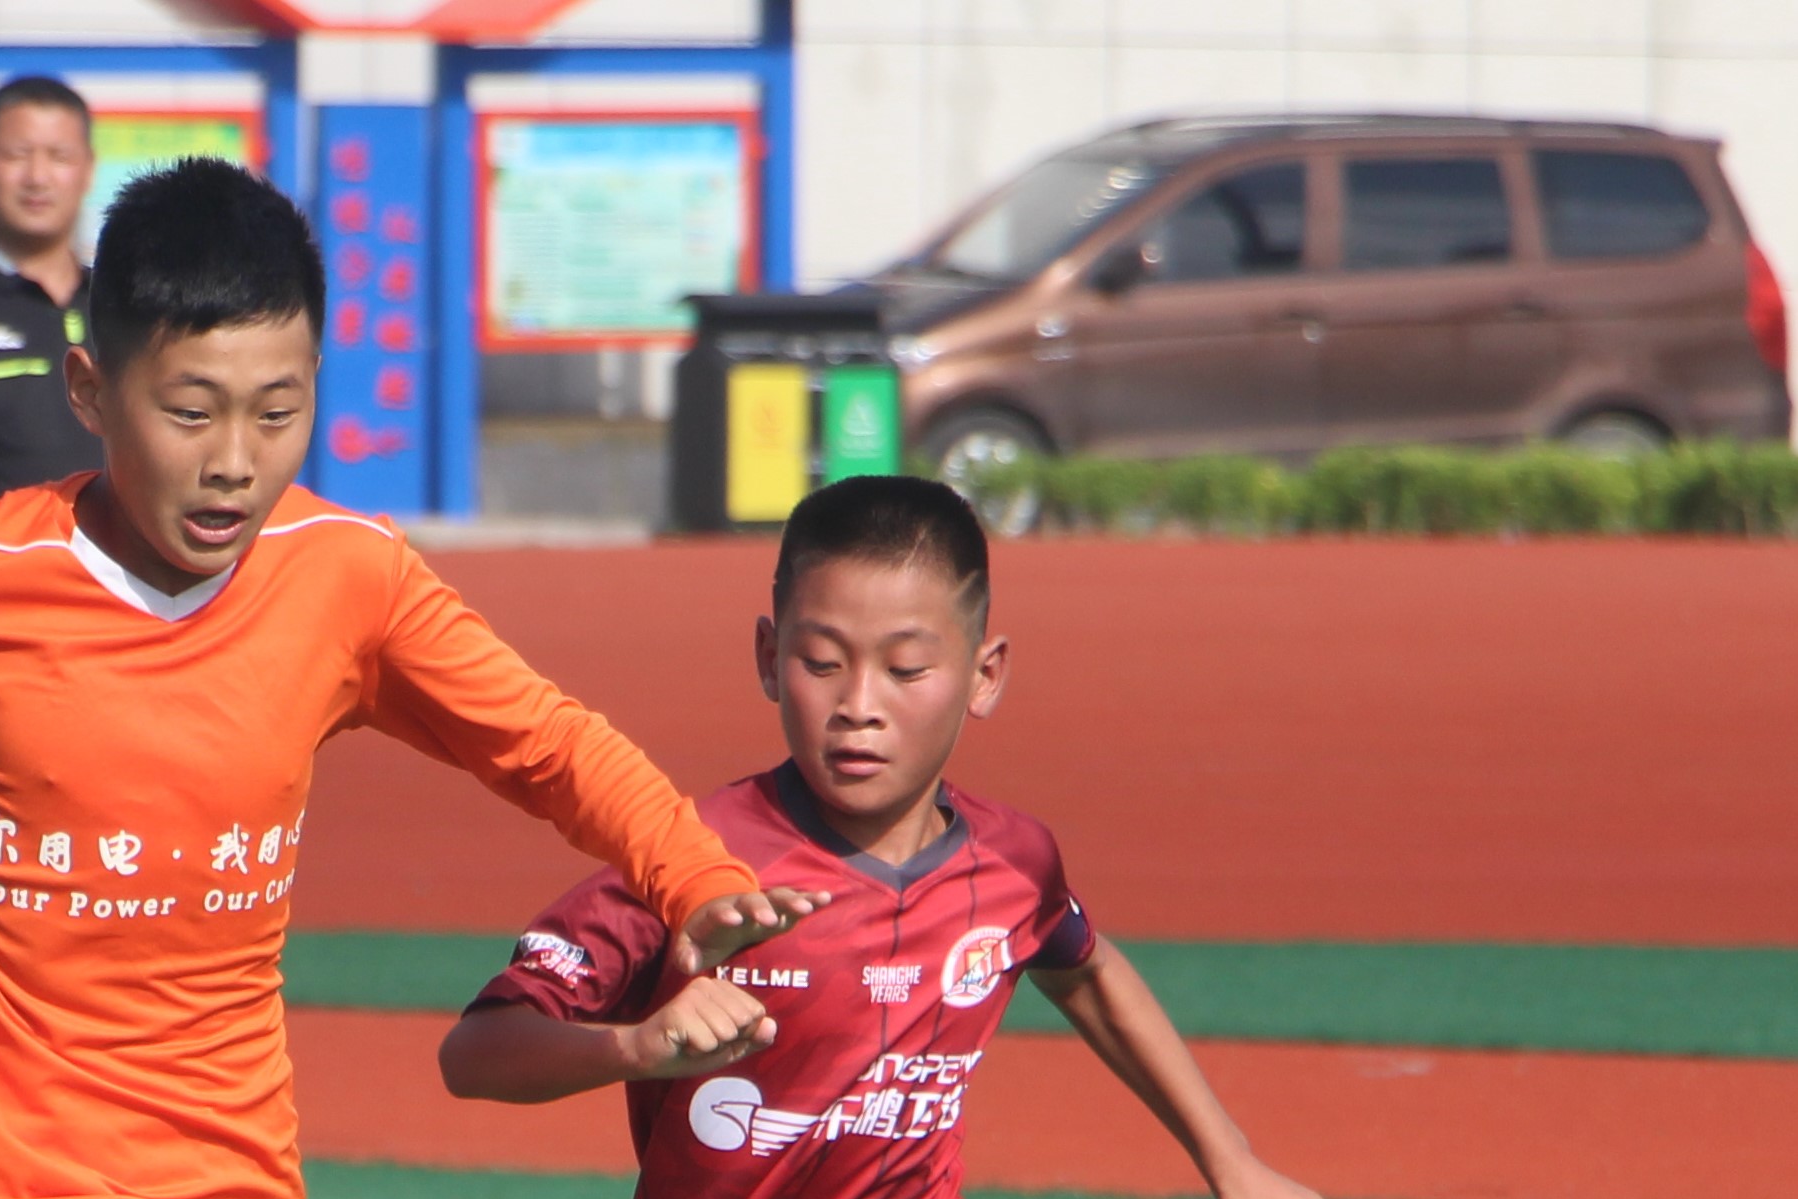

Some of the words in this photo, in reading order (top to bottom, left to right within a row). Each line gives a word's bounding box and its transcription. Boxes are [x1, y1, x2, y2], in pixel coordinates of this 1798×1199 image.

[68, 892, 176, 919] Power
[204, 889, 258, 913] Our
[715, 965, 810, 988] KELME
[861, 965, 922, 985] SHANGHE
[870, 984, 910, 1004] YEARS
